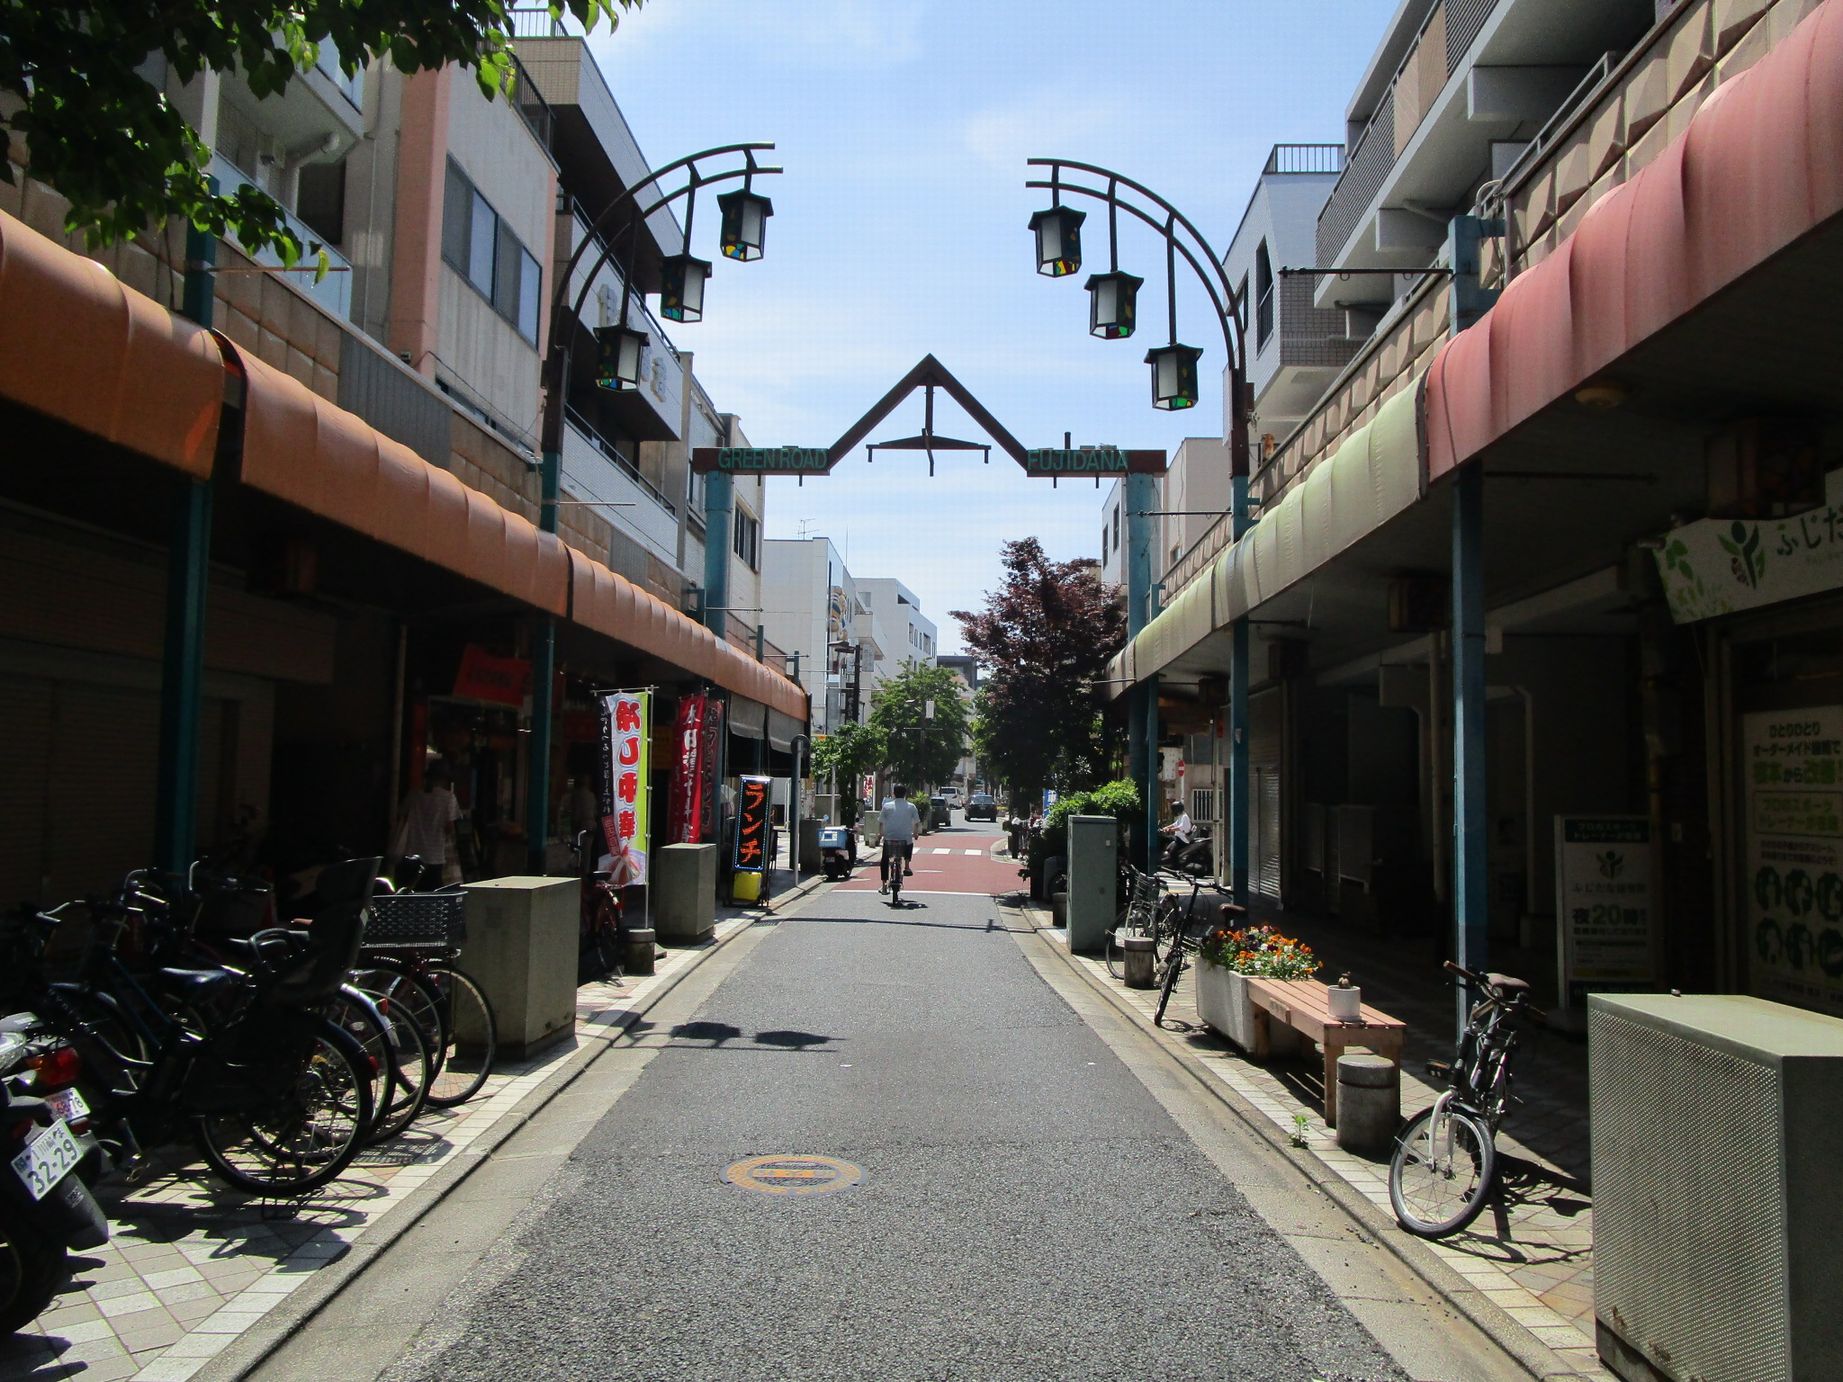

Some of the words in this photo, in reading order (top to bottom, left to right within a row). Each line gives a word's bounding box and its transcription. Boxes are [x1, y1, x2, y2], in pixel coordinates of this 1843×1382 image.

[718, 448, 776, 469] GREEN
[780, 449, 828, 469] ROAD
[1027, 450, 1128, 471] FUJIDANA
[740, 783, 765, 863] ランチ
[27, 1138, 78, 1194] 32-29
